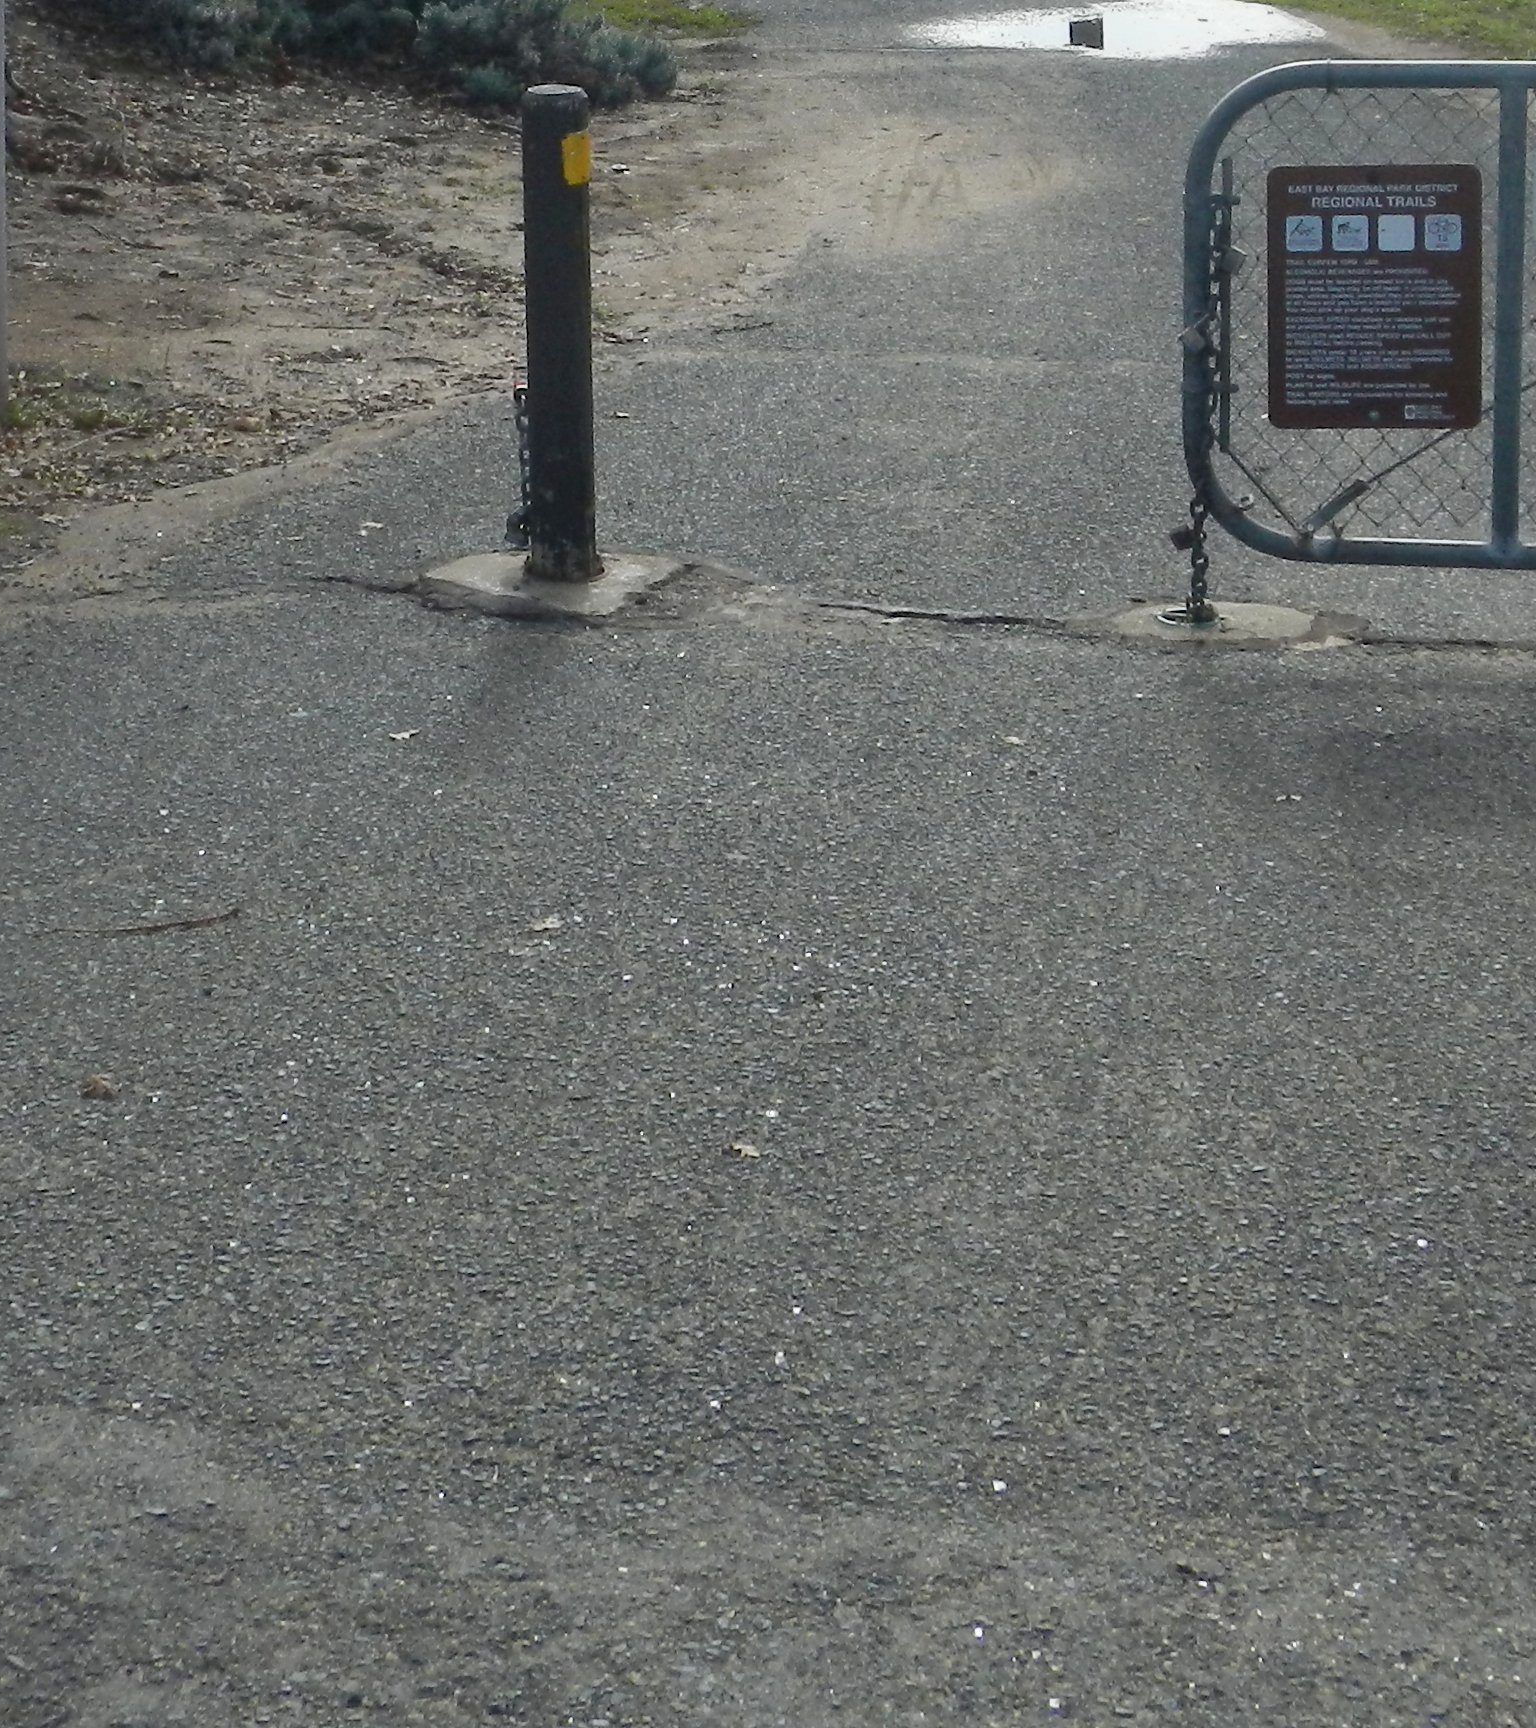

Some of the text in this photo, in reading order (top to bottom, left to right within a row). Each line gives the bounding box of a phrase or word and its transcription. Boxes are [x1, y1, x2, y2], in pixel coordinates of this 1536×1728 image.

[1288, 183, 1458, 194] EAST BAY REGIONAL PARK DISTRICT
[1311, 195, 1437, 208] REGIONAL TRAILS
